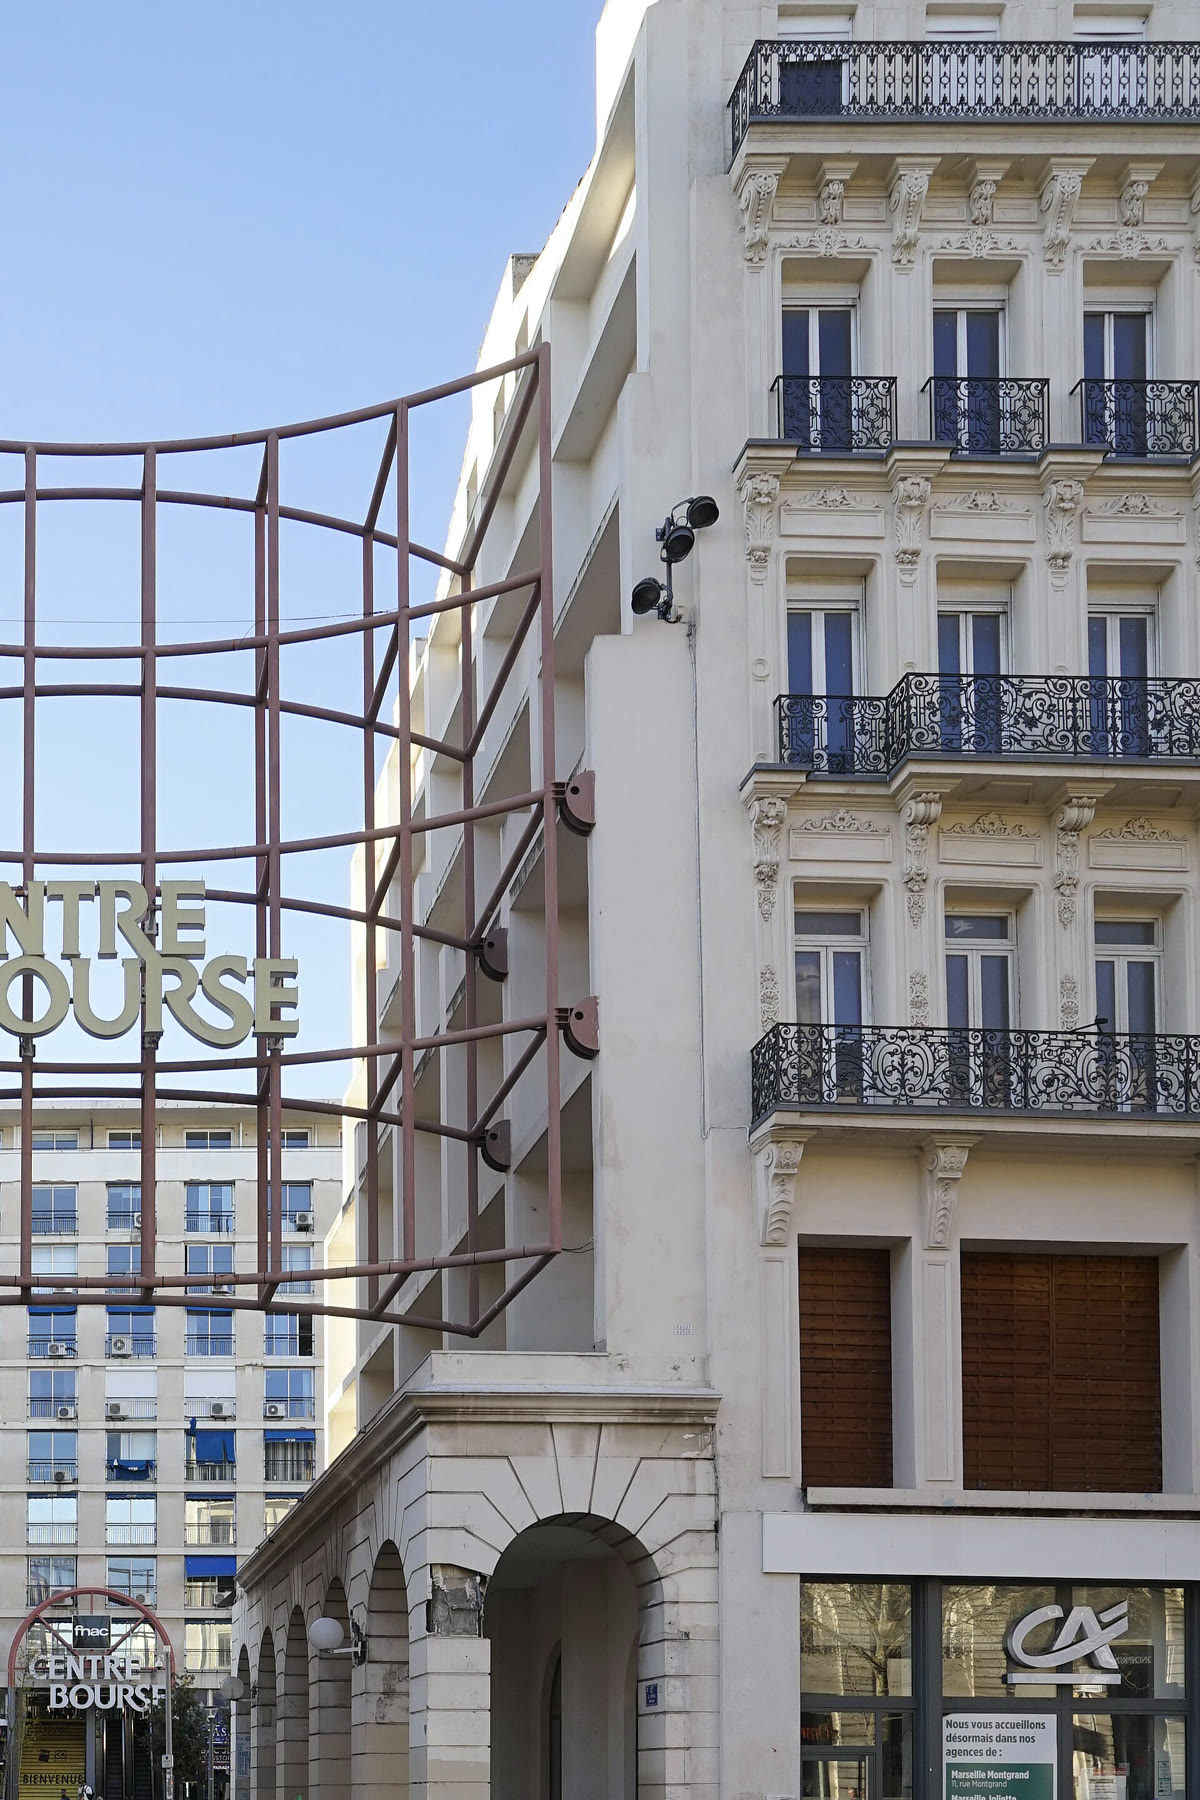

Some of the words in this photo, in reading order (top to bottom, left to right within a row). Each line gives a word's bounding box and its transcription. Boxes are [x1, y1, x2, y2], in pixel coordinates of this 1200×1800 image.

[74, 1625, 109, 1637] fnac
[1008, 1600, 1128, 1669] CA
[29, 1654, 142, 1682] CENTRE
[946, 1720, 969, 1729] Nous
[995, 1720, 1046, 1729] accueillons
[946, 1733, 993, 1742] désormais
[996, 1734, 1017, 1743] dans
[946, 1748, 983, 1758] agences
[986, 1747, 997, 1756] de
[23, 1775, 83, 1784] BIENVENUE
[952, 1770, 986, 1779] Marseille
[987, 1771, 1029, 1780] Montgrand
[972, 1780, 1007, 1788] Montgrand
